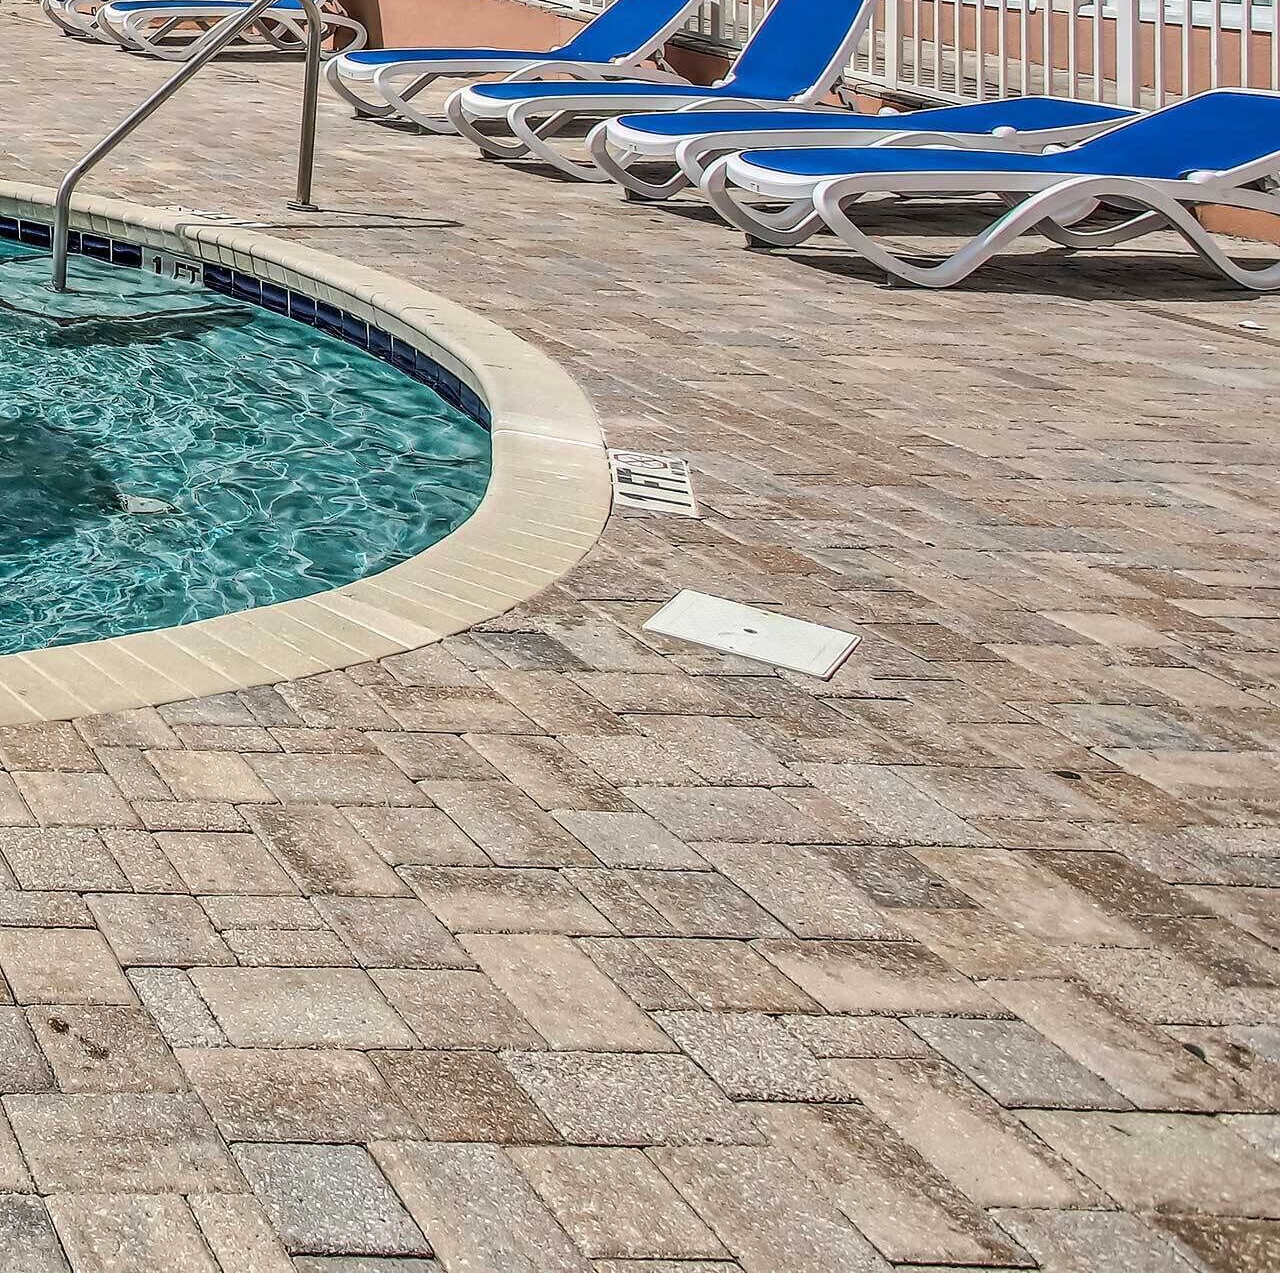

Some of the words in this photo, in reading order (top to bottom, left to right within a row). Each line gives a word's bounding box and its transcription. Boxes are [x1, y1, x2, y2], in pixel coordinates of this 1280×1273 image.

[152, 256, 162, 275] 1
[173, 262, 201, 284] FT
[616, 467, 689, 494] FT
[618, 491, 692, 507] 1
